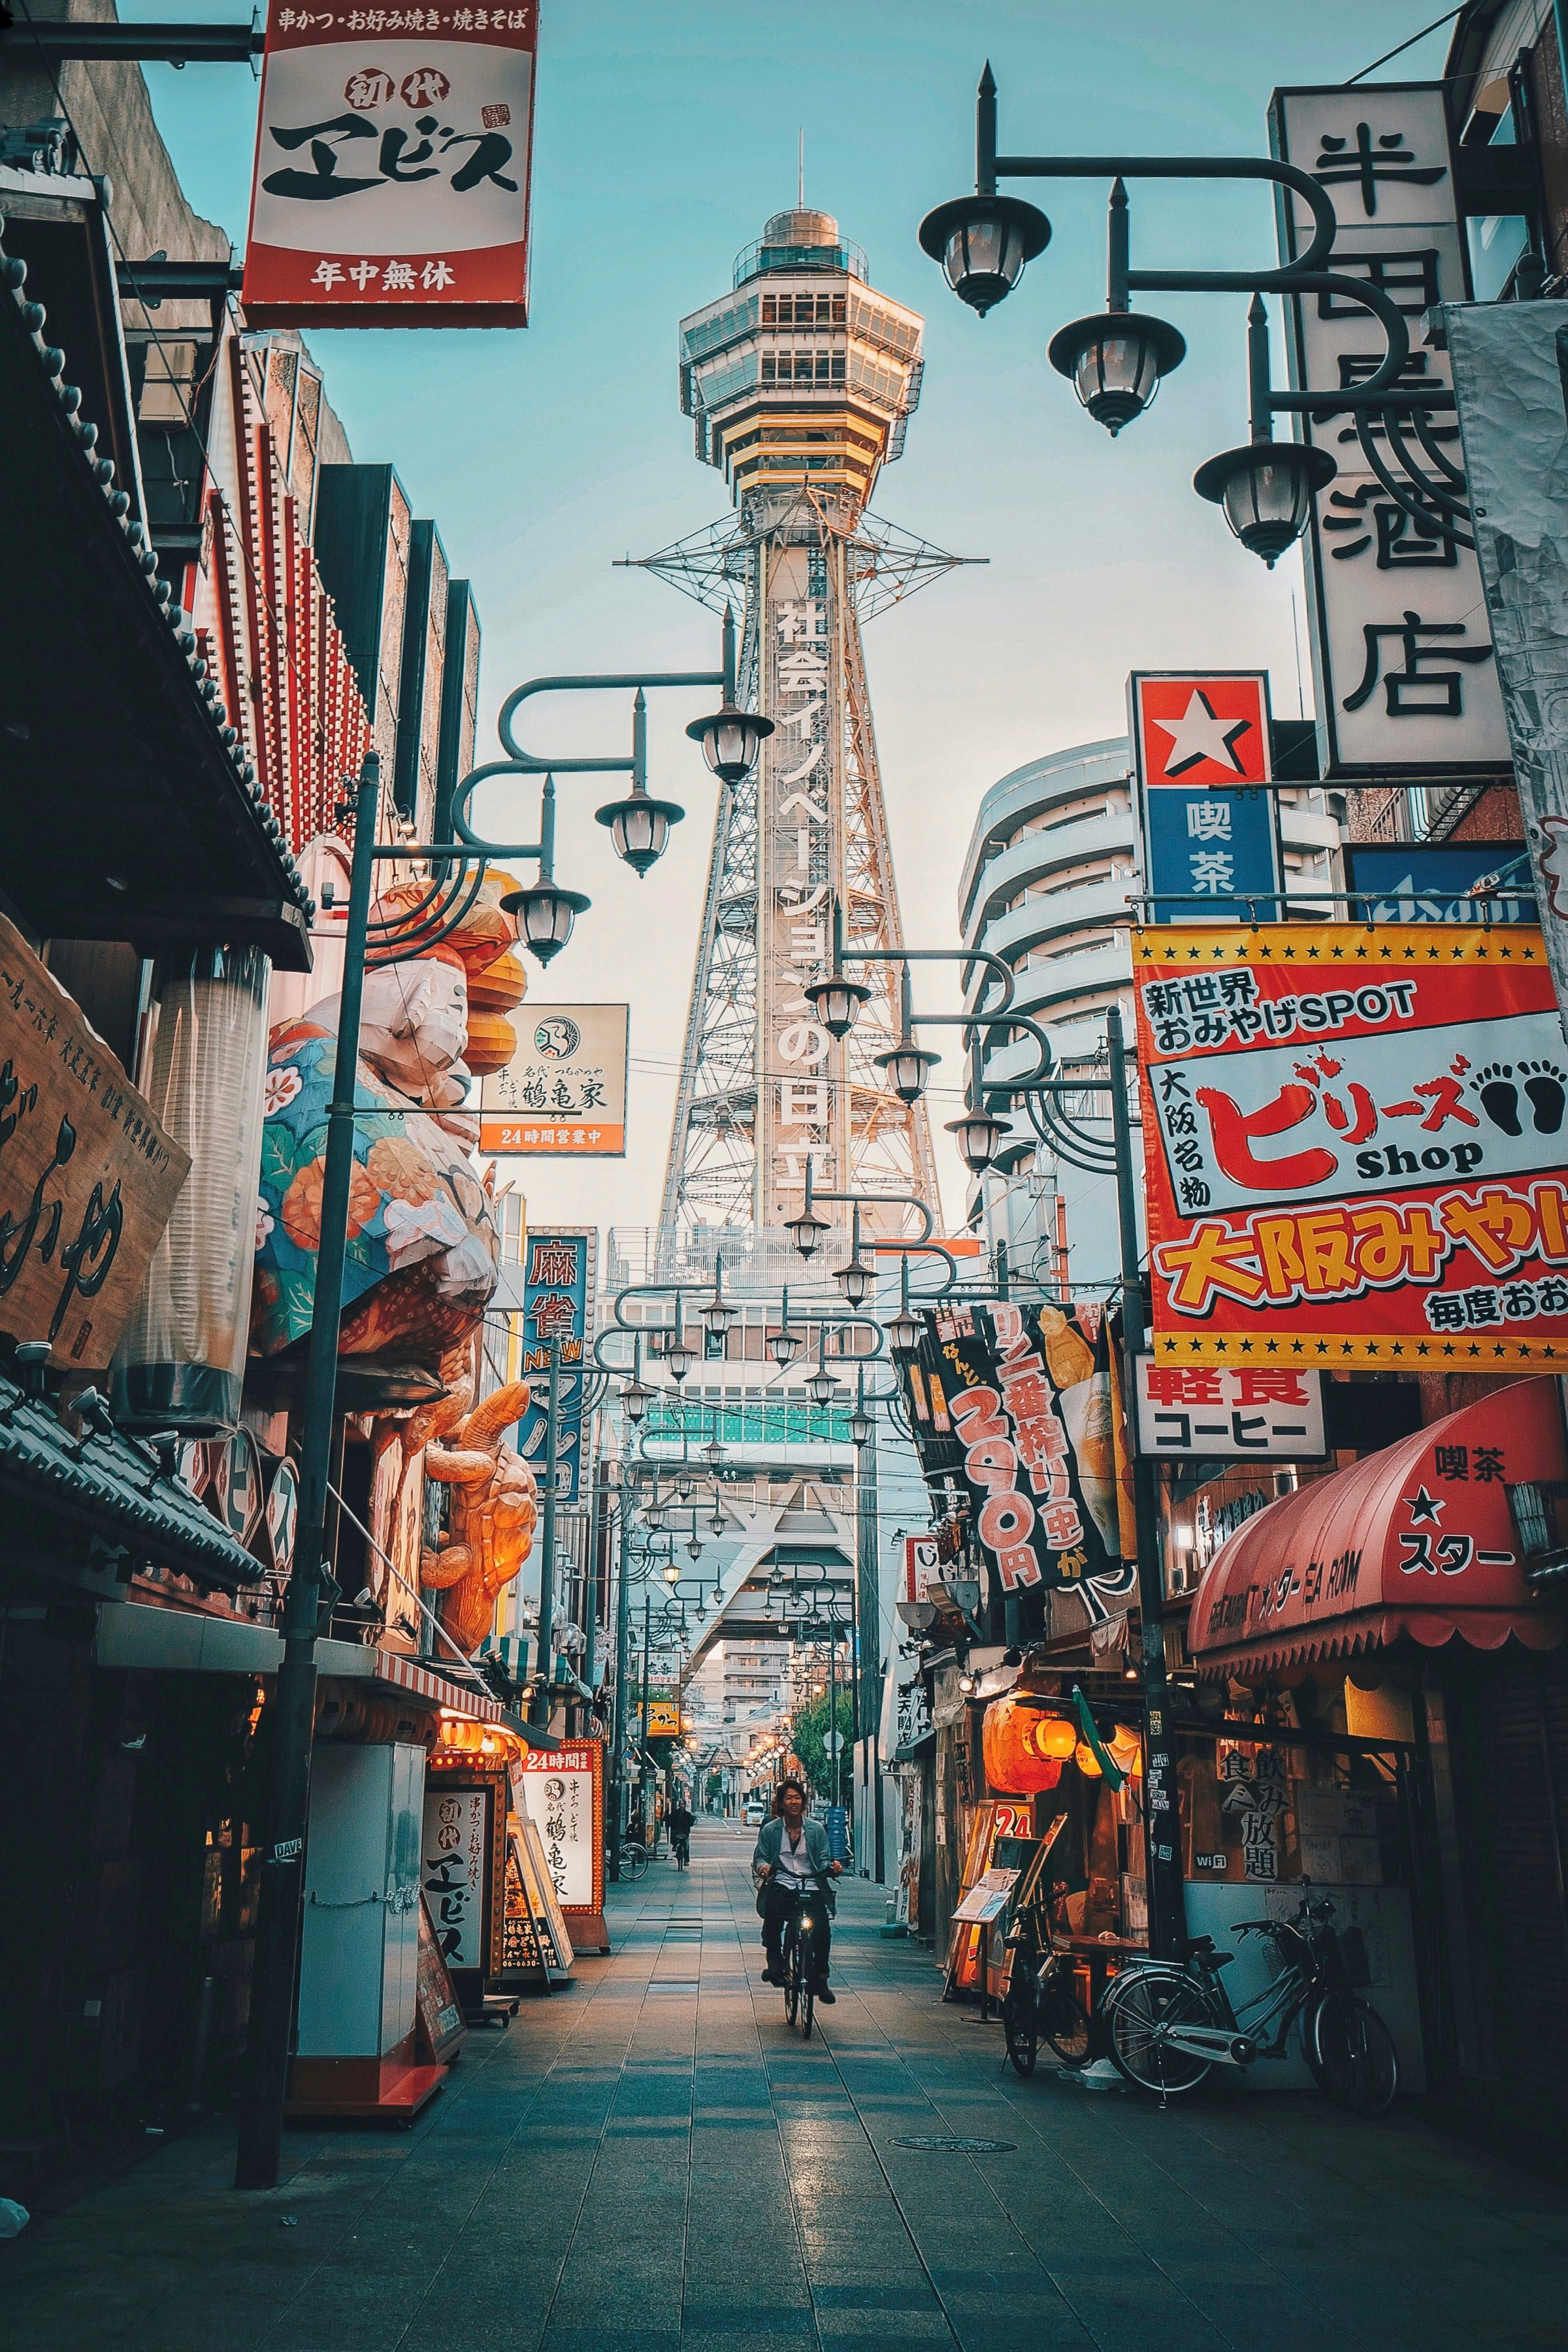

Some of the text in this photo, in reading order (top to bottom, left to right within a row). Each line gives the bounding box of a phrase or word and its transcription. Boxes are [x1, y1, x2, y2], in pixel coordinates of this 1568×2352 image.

[278, 8, 529, 31] 串かつ・お好み焼き・焼きそば
[350, 70, 447, 108] 初代
[310, 261, 456, 291] 年中無休
[1186, 802, 1235, 894] 喫茶
[1145, 973, 1256, 1019] 新世界
[1156, 983, 1415, 1049] おみやげSPOT
[521, 1078, 608, 1109] 鶴亀家
[501, 1128, 602, 1145] 24時間営業中
[1158, 1069, 1211, 1210] 大阪名物
[1195, 1045, 1480, 1190] ビリーズ
[527, 1240, 578, 1339] 麻雀
[1146, 1363, 1311, 1407] 軽食
[1154, 1411, 1307, 1448] コーヒー
[1435, 1445, 1507, 1484] 喫茶
[949, 1386, 1044, 1592] 290円
[1399, 1533, 1516, 1576] スター
[1220, 1748, 1256, 1813] 食べ
[1254, 1749, 1290, 1814] 飲み
[545, 1803, 566, 1812] 名代
[276, 1838, 302, 1857] DAVE
[544, 1813, 569, 1896] 鶴亀家
[1243, 1813, 1277, 1880] 放題
